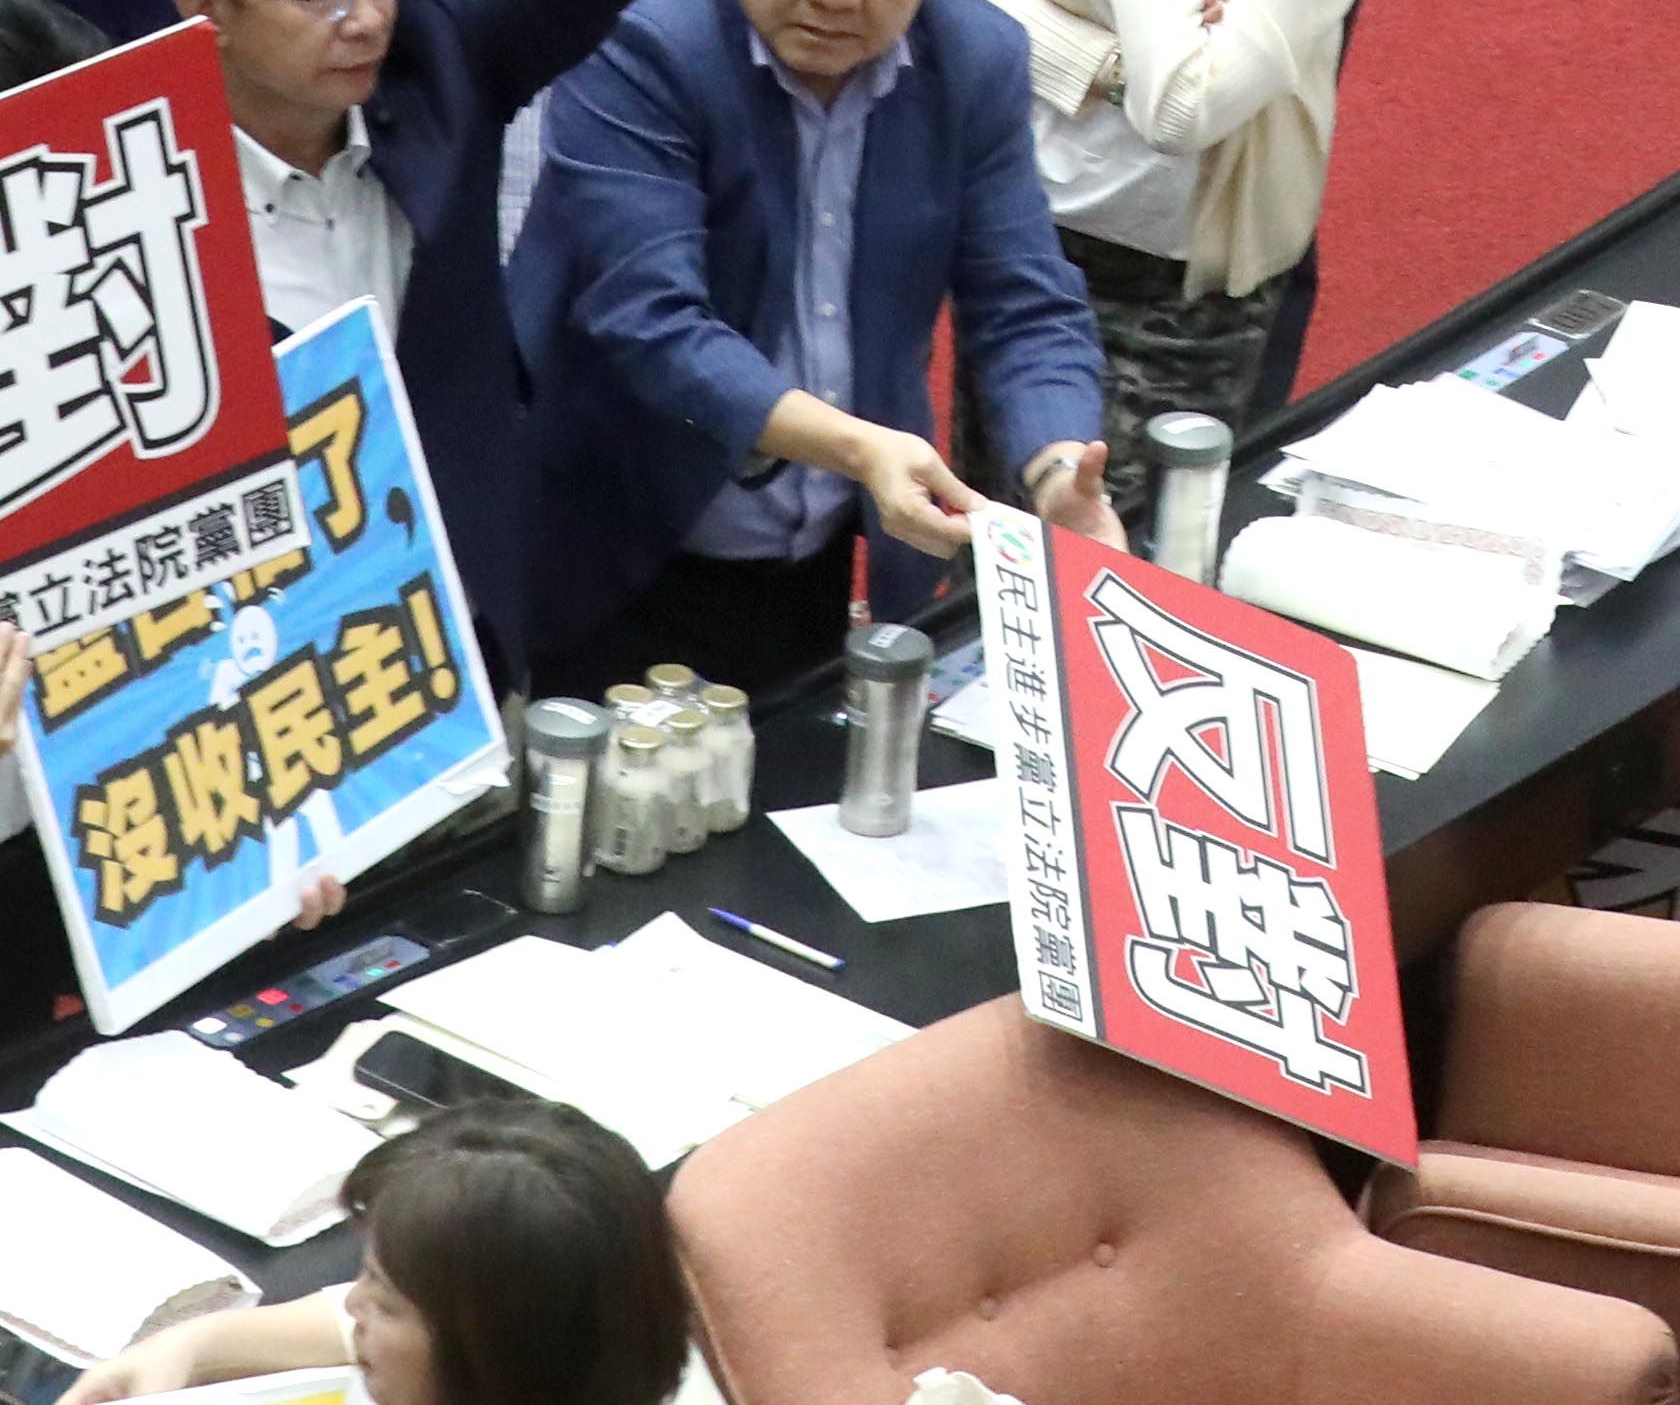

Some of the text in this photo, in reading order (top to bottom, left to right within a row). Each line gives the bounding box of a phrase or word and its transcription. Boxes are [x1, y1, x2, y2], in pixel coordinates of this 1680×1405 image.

[74, 572, 457, 926] 沒收民主！
[993, 563, 1084, 1022] 民主進步黨立法院黨團
[1085, 566, 1372, 1098] 反對
